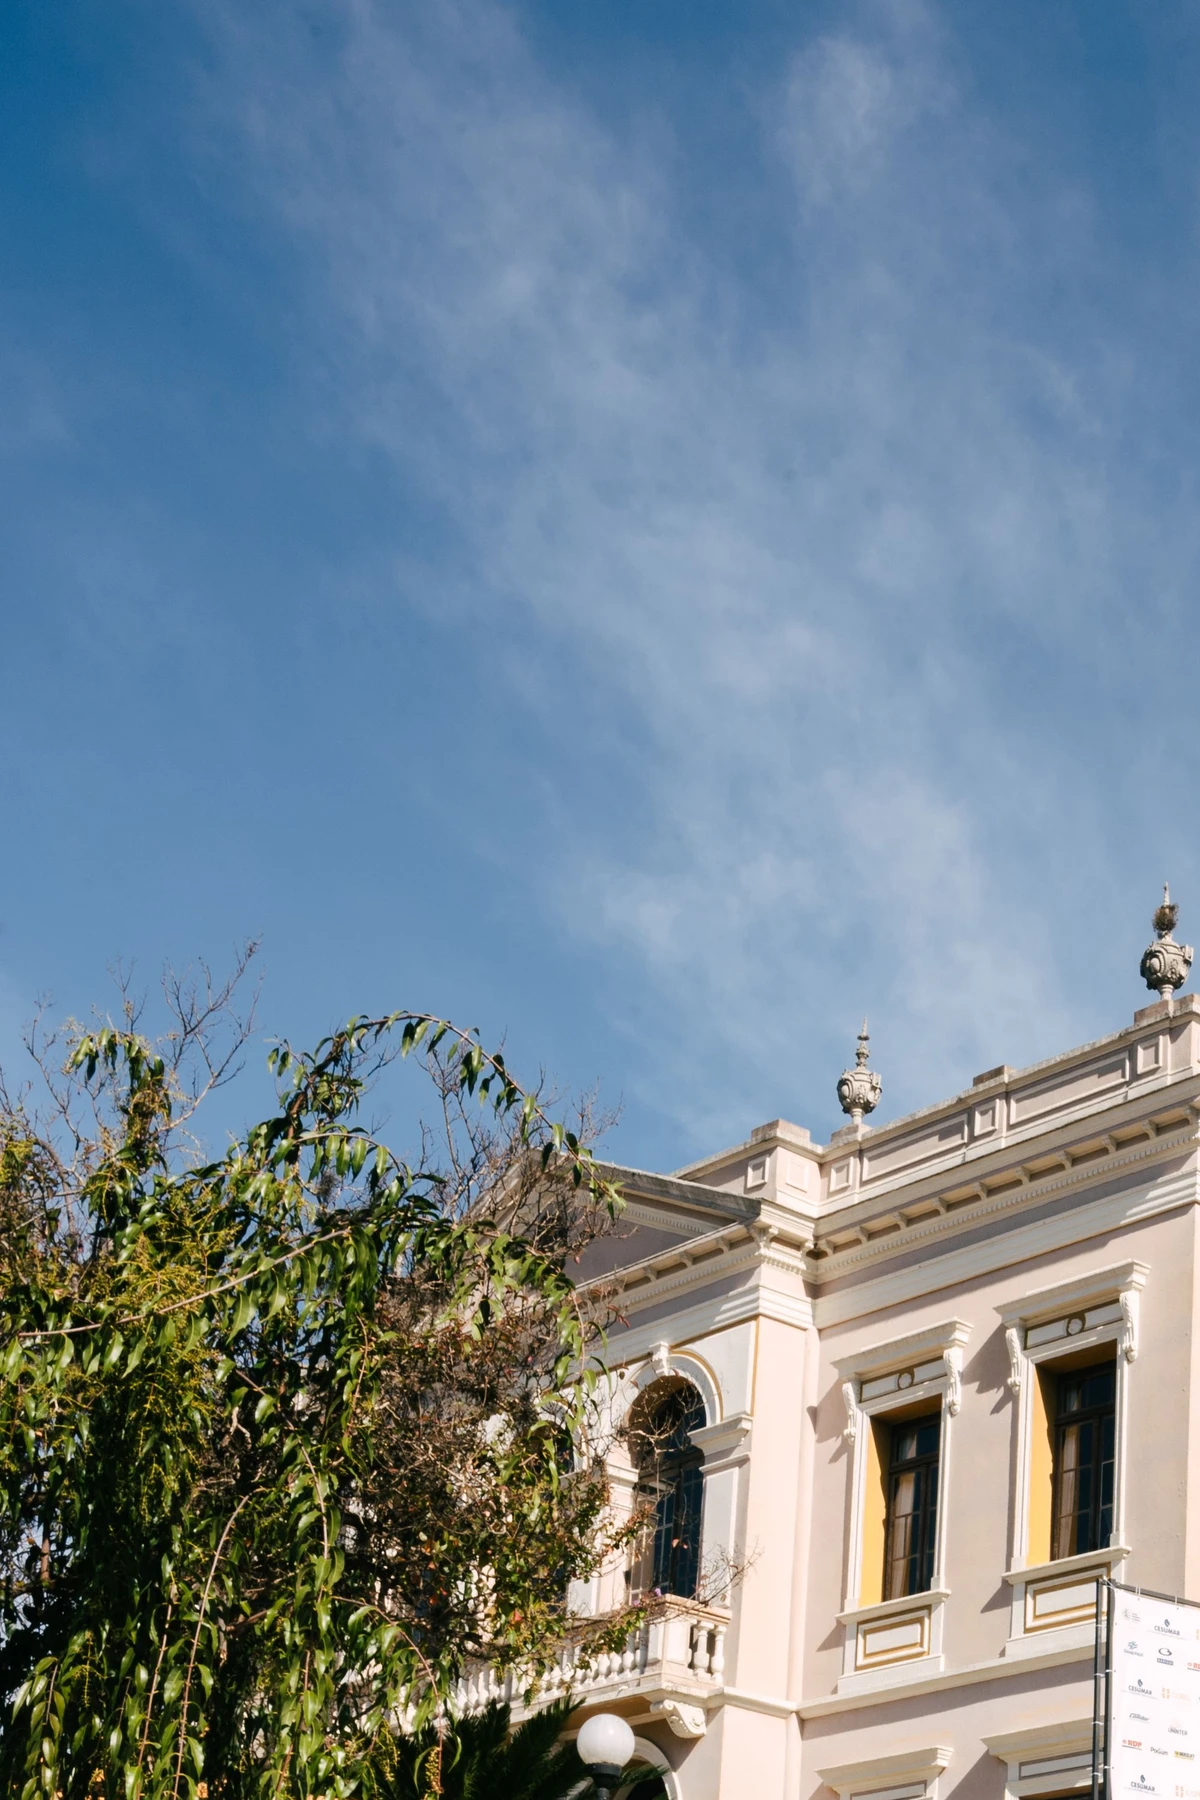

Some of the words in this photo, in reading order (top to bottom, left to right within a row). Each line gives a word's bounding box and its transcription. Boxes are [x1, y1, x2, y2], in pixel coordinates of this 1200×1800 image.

[1154, 1625, 1180, 1636] CESUMAR
[1128, 1685, 1152, 1695] CESUMAR
[1128, 1740, 1142, 1748] RDP
[1130, 1782, 1155, 1792] CESUMAR
